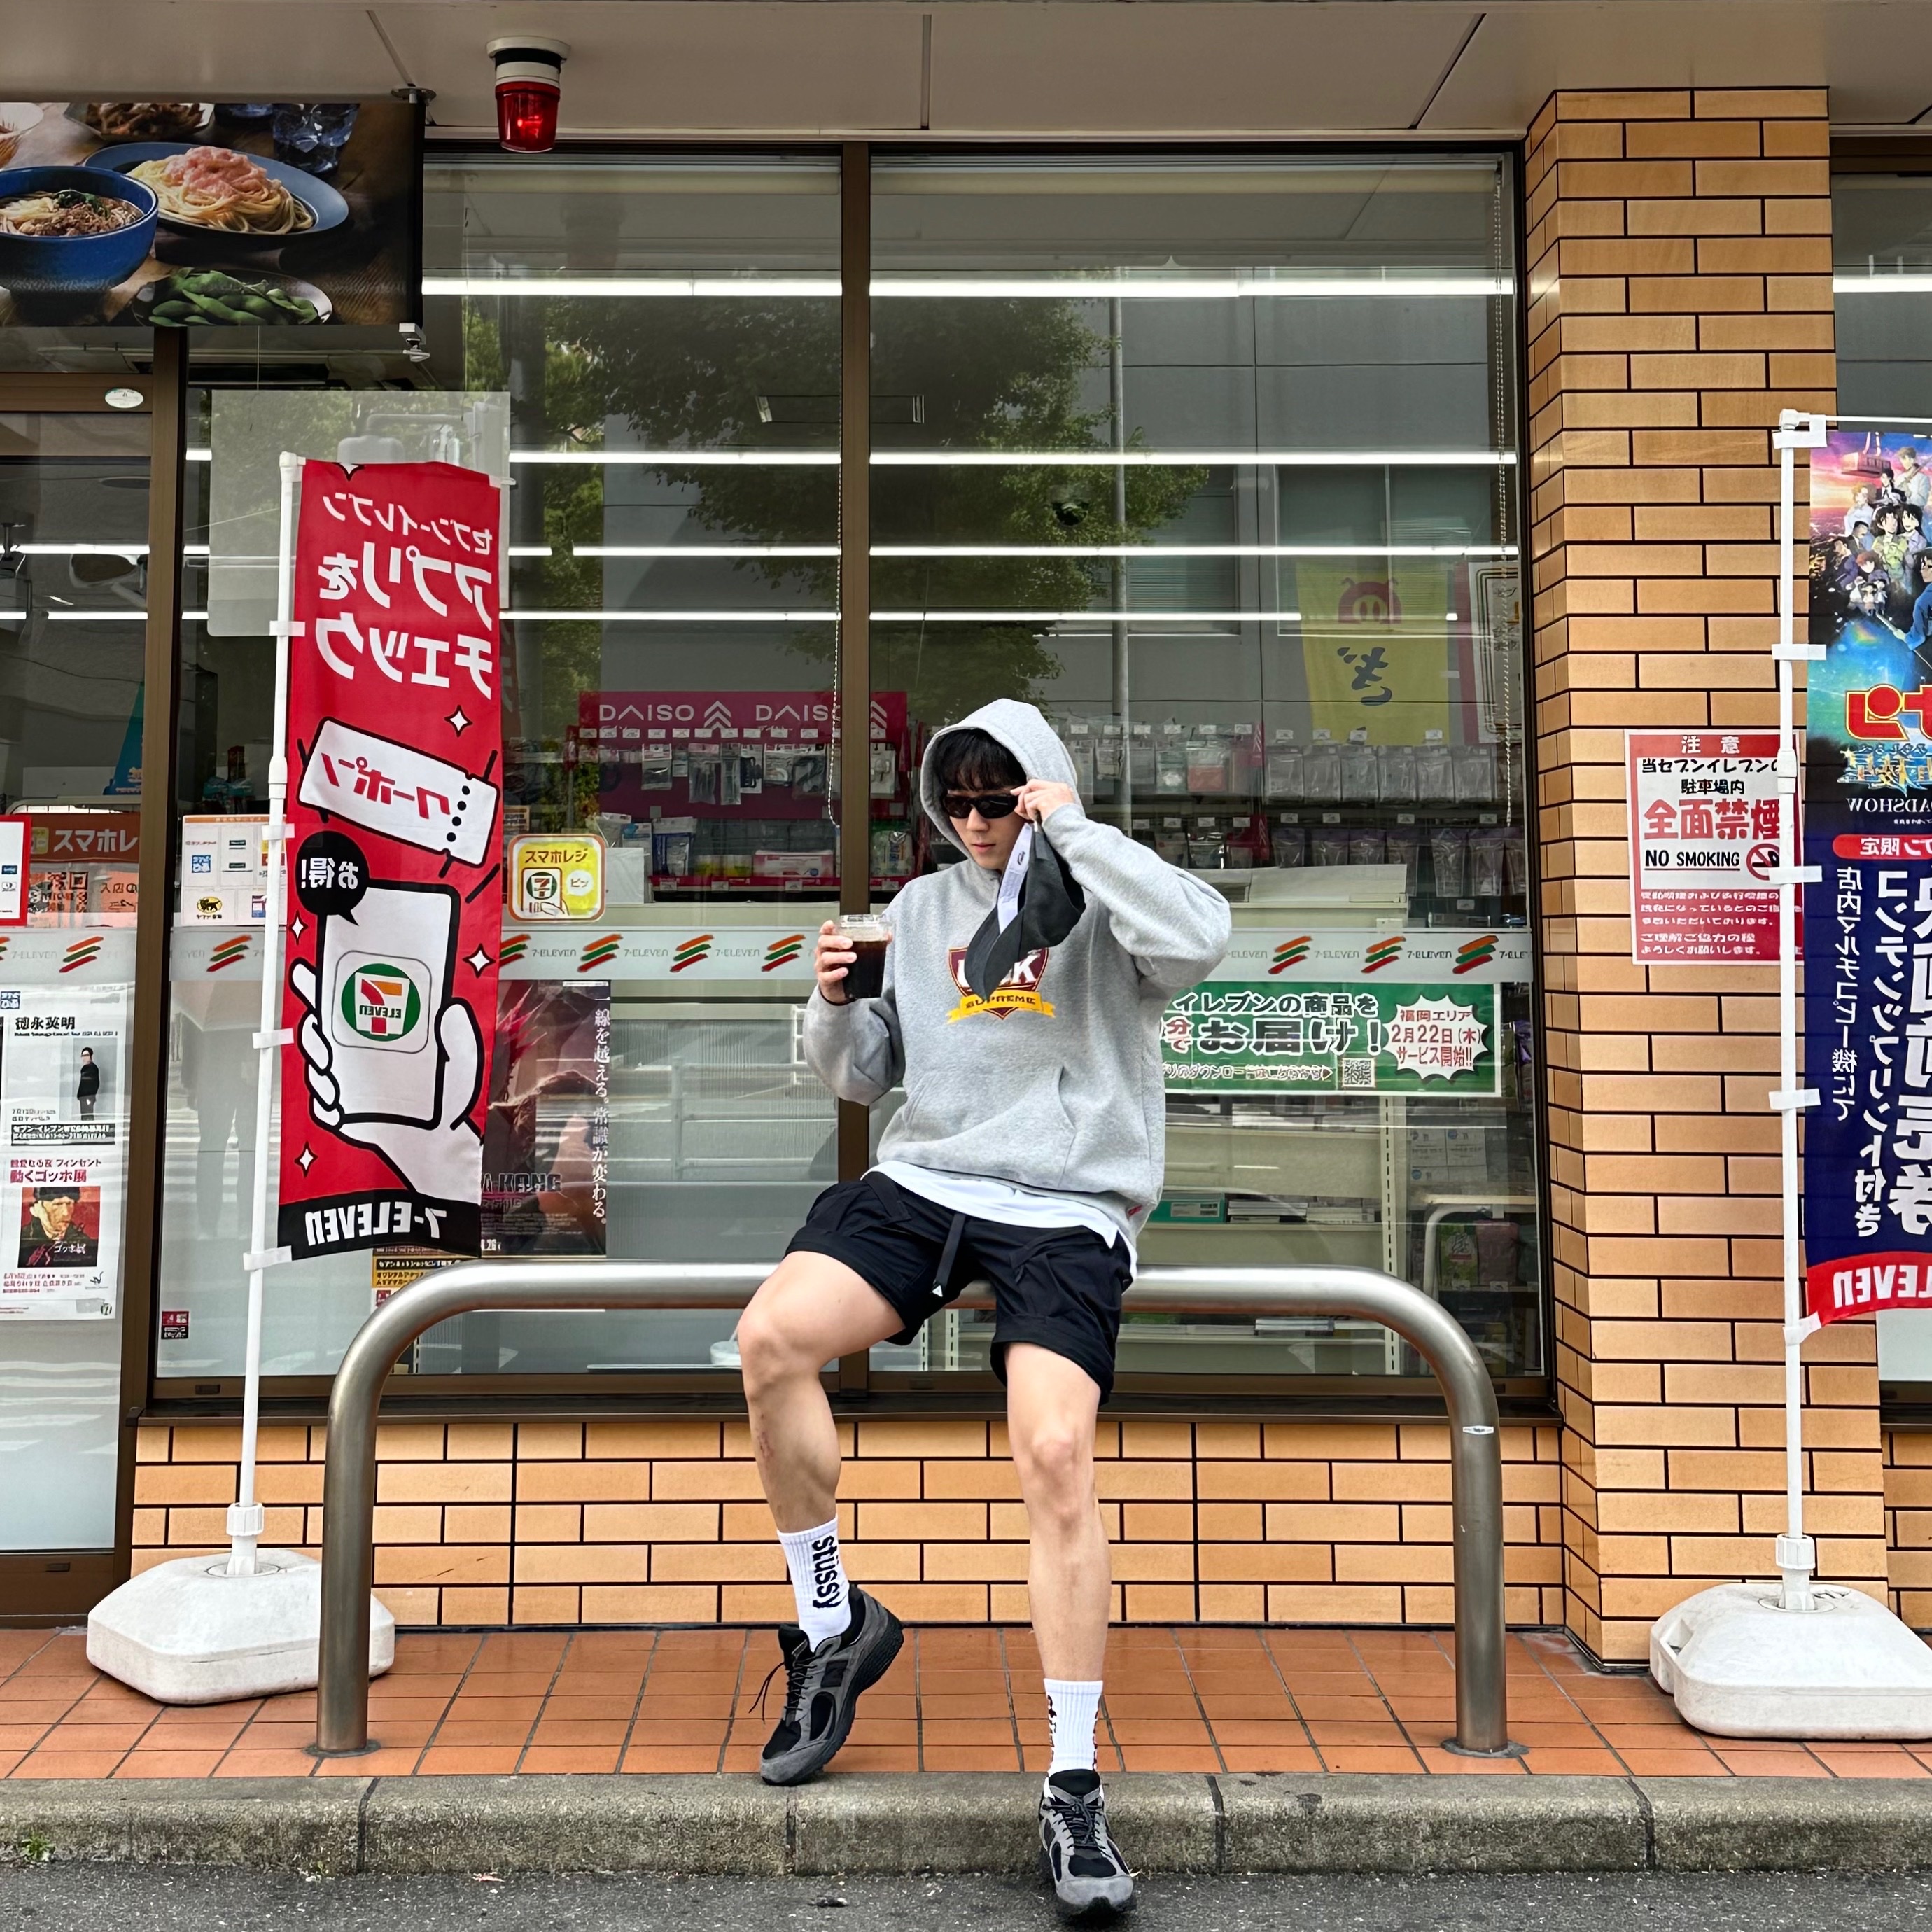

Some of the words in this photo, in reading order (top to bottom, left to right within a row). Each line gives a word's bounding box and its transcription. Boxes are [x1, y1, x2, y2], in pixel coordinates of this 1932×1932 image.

[599, 704, 695, 722] DAISO
[1681, 779, 1745, 794] 駐車場内
[1644, 799, 1781, 840] 全面禁煙
[525, 848, 588, 863] スマホレジ
[1645, 850, 1670, 867] NO
[1676, 851, 1740, 867] SMOKING
[1400, 1009, 1473, 1022] 福岡エリア
